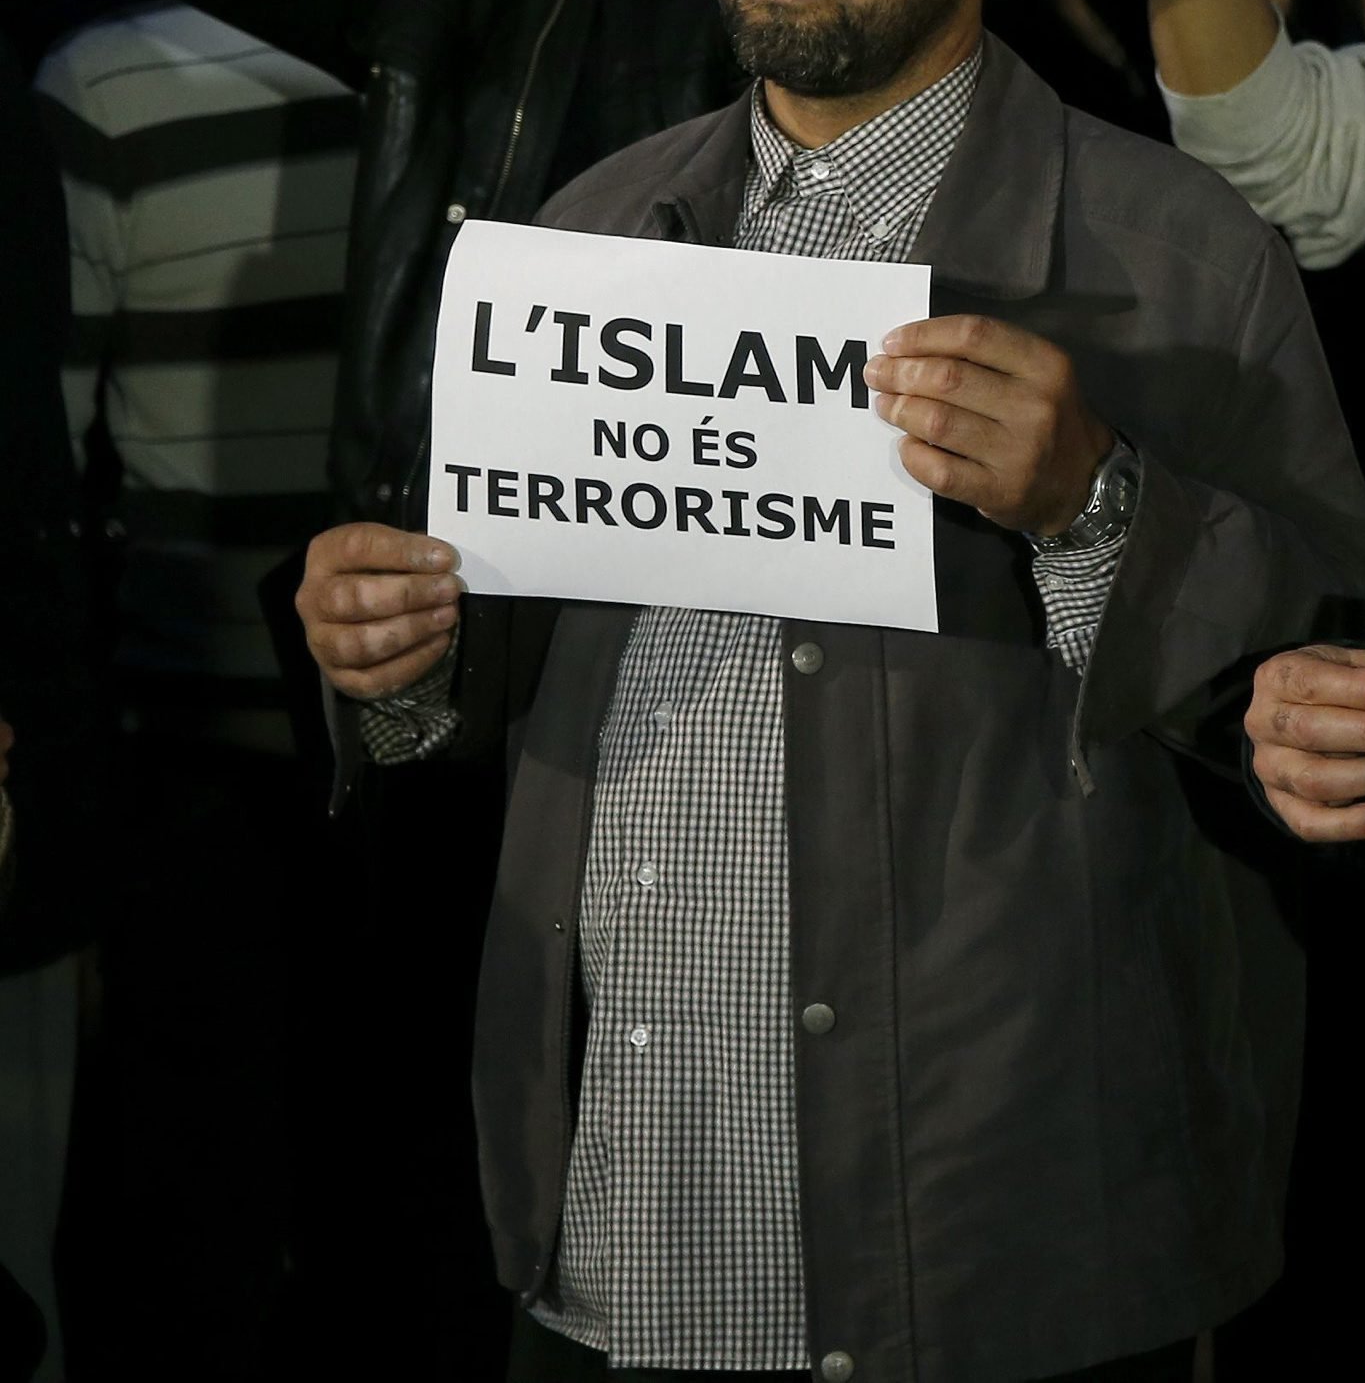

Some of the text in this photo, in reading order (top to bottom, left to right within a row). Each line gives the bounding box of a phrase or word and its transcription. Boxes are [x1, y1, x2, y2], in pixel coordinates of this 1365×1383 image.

[471, 300, 870, 410] L'ISLAM
[593, 415, 758, 470] NO ÉS
[443, 463, 896, 550] TERRORISME
